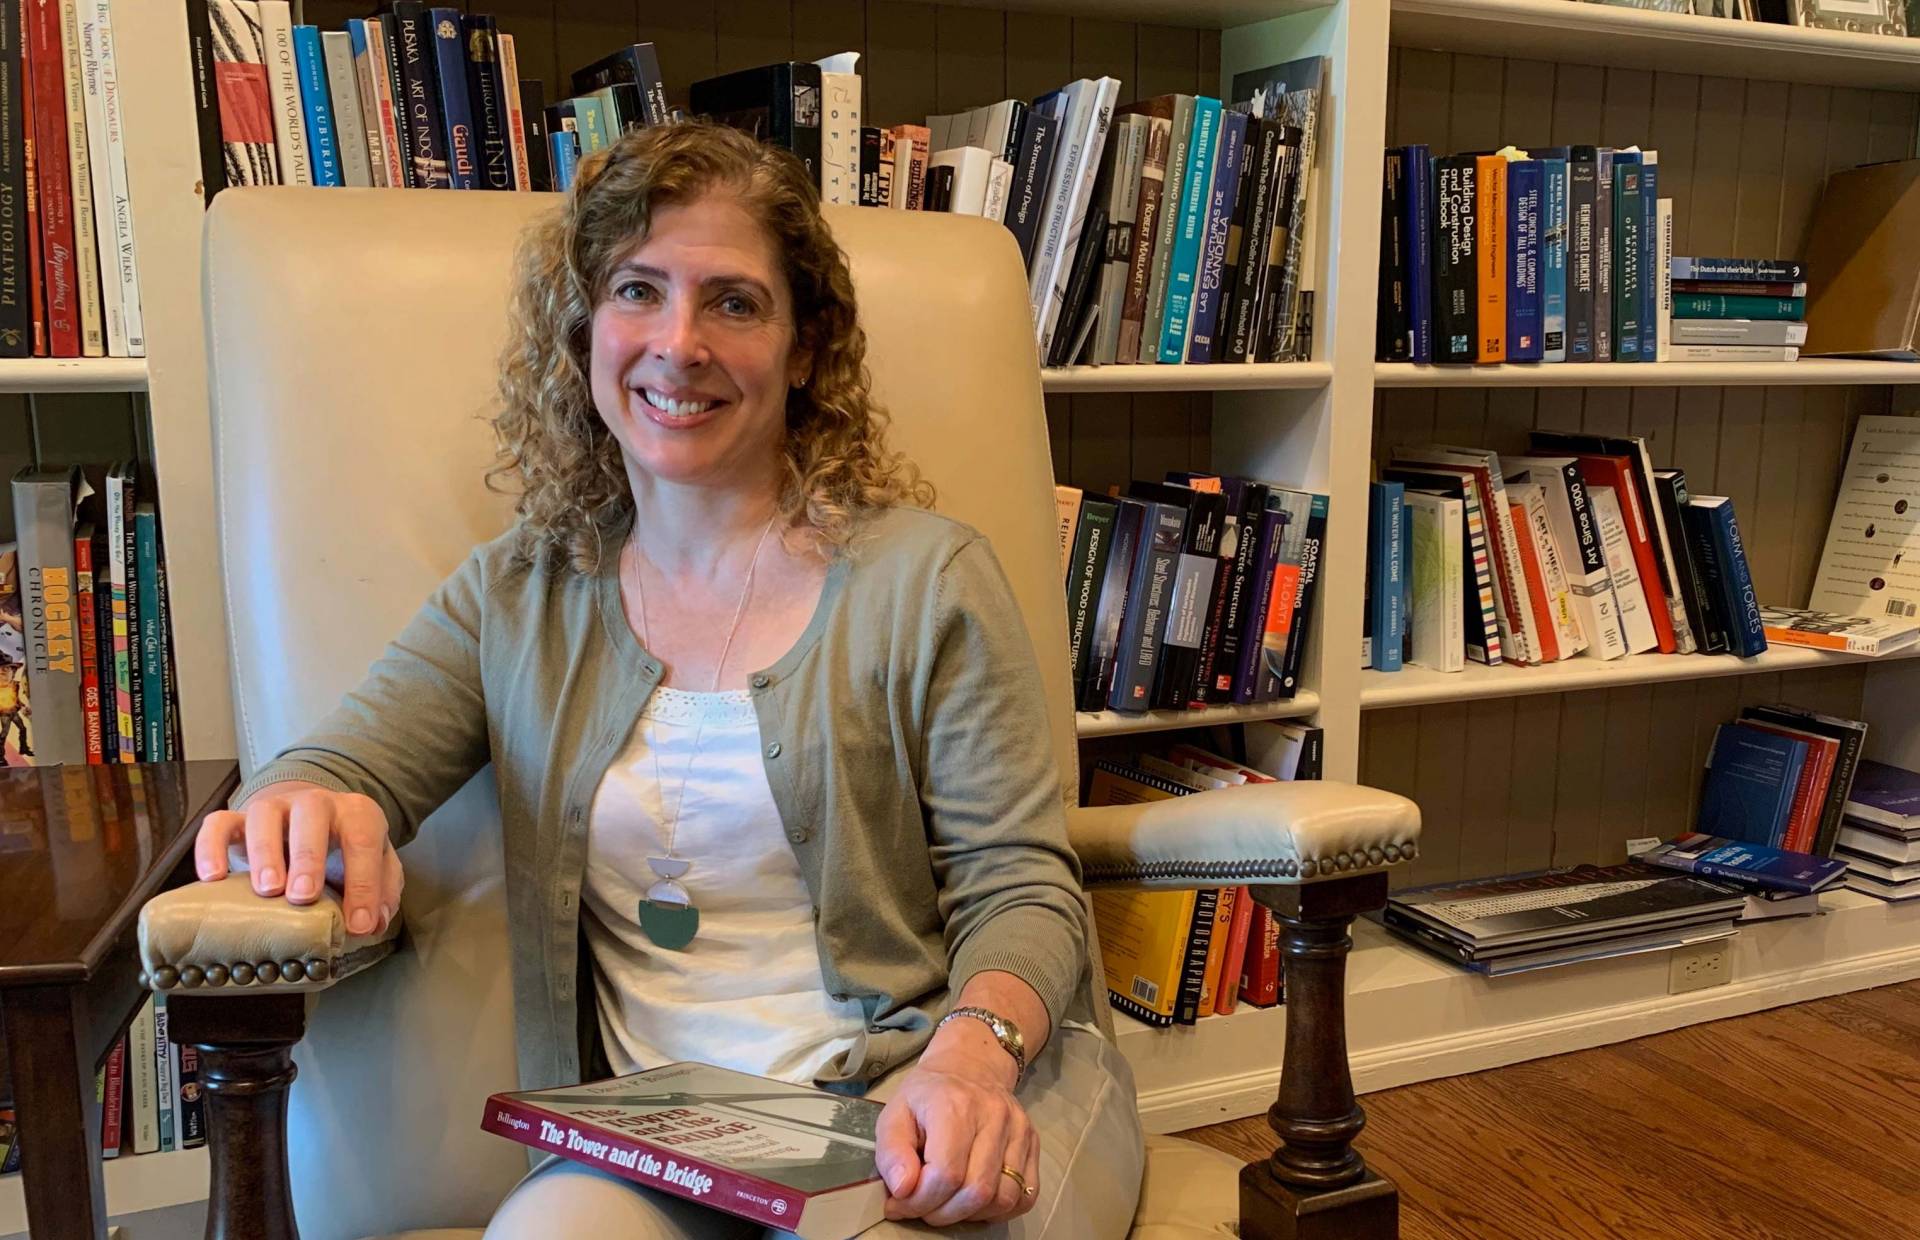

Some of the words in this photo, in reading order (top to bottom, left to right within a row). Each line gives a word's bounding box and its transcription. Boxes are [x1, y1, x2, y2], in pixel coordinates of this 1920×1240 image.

[98, 4, 107, 24] BIG
[82, 22, 95, 58] Nursery
[101, 28, 111, 59] BOOK
[276, 28, 288, 48] 100
[390, 36, 399, 66] RICHARD
[402, 20, 419, 64] PUSAKA
[69, 49, 78, 69] Book
[279, 50, 290, 66] OF
[86, 60, 98, 96] Rhymes
[281, 70, 293, 92] THE
[310, 60, 319, 91] CONNOR
[394, 70, 402, 91] SERRA
[410, 79, 423, 99] ART
[72, 83, 80, 113] Virtues
[106, 80, 120, 143] DINOSAURS
[479, 72, 498, 135] THROUGH
[285, 95, 302, 151] WORLD'S
[415, 104, 427, 122] OF
[73, 122, 83, 149] Edited
[1034, 126, 1047, 143] The
[1197, 110, 1213, 159] FUNDAMENTALS
[1262, 130, 1274, 168] Candela:
[453, 124, 473, 176] Gaudi
[1026, 143, 1043, 184] Structure
[1196, 159, 1204, 170] OF
[76, 163, 87, 197] William
[1059, 144, 1080, 202] EXPRESSING
[1172, 143, 1185, 200] GUASTAVINO
[1259, 168, 1269, 184] The
[1451, 168, 1462, 191] and
[1024, 185, 1034, 195] of
[1215, 189, 1225, 206] DE
[1256, 184, 1268, 206] Shell
[1440, 169, 1451, 229] Handbook
[1460, 168, 1474, 214] Building
[1527, 189, 1538, 210] STEEL,
[81, 206, 89, 238] Bennett
[116, 195, 128, 239] ANGELA
[1017, 195, 1031, 224] Design
[1140, 203, 1156, 238] ROBERT
[1164, 202, 1178, 245] VAULTING
[1490, 193, 1499, 232] Mechanics
[1518, 197, 1529, 221] DESIGN
[1625, 217, 1632, 230] OF
[1043, 204, 1065, 258] STRUCTURE
[1451, 194, 1462, 265] Construction
[1460, 216, 1474, 256] Design
[1518, 223, 1528, 232] OF
[1555, 205, 1563, 269] STRUCTURES
[1579, 203, 1591, 251] REINFORCED
[1, 182, 16, 307] PIRATEOLOGY
[1202, 208, 1222, 290] ESTRUCTURAS
[1209, 216, 1230, 290] CANDELA
[1517, 235, 1528, 251] TALL
[121, 241, 134, 284] WILKES
[1135, 240, 1150, 284] MAILLART
[1245, 261, 1256, 286] Faber
[1490, 244, 1498, 279] Engineers
[1516, 253, 1528, 289] BUILDINGS
[1526, 257, 1538, 295] COMPOSITE
[1578, 253, 1591, 293] CONCRETE
[1700, 264, 1717, 273] Dutch
[1717, 265, 1725, 273] and
[1726, 264, 1740, 273] their
[1740, 265, 1754, 274] Delta
[1198, 292, 1210, 313] LAS
[1664, 272, 1672, 311] NATION
[1237, 299, 1250, 336] Reinhold
[1391, 496, 1400, 512] THE
[1570, 483, 1585, 512] 1900
[1086, 512, 1110, 525] Breyer
[1391, 513, 1400, 539] WATER
[1503, 514, 1518, 545] Portfolio
[1537, 515, 1549, 535] ART
[1578, 512, 1597, 547] Since
[126, 532, 136, 545] THE
[1087, 528, 1101, 564] DESIGN
[1237, 525, 1254, 573] Concrete
[1391, 540, 1400, 560] WILL
[1727, 518, 1743, 558] FORM
[127, 547, 136, 565] LION,
[1156, 558, 1171, 575] Steel
[1304, 538, 1320, 586] COASTAL
[1509, 547, 1522, 575] Design
[1587, 545, 1599, 566] Art
[1084, 565, 1094, 579] OF
[1294, 537, 1312, 609] ENGINEERING
[1390, 560, 1399, 583] COME
[1736, 559, 1750, 583] AND
[128, 580, 137, 602] WITCH
[1079, 580, 1092, 609] WOOD
[1228, 574, 1246, 630] Structures
[1260, 570, 1274, 606] Structures
[1390, 595, 1398, 609] JEFF
[28, 567, 48, 675] CHRONICLE
[42, 567, 75, 673] HOCKEY
[129, 604, 138, 619] AND
[1143, 609, 1161, 635] Behavior
[1741, 583, 1763, 635] FORCES
[130, 621, 138, 633] THE
[146, 619, 157, 636] What
[1071, 609, 1087, 671] STRUCTURES
[1254, 614, 1265, 641] Coastal
[130, 635, 140, 671] WARDROBE
[1140, 636, 1154, 648] and
[1138, 649, 1153, 667] LRFD
[1249, 641, 1261, 677] Resilience
[85, 686, 98, 708] GOES
[133, 679, 142, 692] THE
[133, 693, 143, 713] MOVIE
[88, 711, 101, 754] BANANAS!
[135, 715, 144, 753] STORYBOOK
[1847, 736, 1858, 757] CITY
[1841, 758, 1852, 779] AND
[1835, 780, 1848, 804] PORT
[1184, 892, 1218, 994] PHOTOGRAPHY
[155, 1012, 167, 1030] BAD
[155, 1036, 169, 1060] KITTY
[108, 1076, 120, 1127] Wonderland
[142, 1090, 150, 1109] CREEK
[496, 1110, 531, 1132] Billington
[570, 1109, 628, 1121] The
[598, 1108, 700, 1129] TOWER
[629, 1123, 670, 1137] and
[669, 1117, 721, 1132] the
[650, 1121, 758, 1146] BRIDGE
[538, 1120, 565, 1146] The
[566, 1128, 609, 1161] Tower
[608, 1146, 640, 1171] and
[637, 1154, 663, 1177] the
[662, 1160, 714, 1195] Bridge
[736, 1190, 769, 1206] PRINCETON
